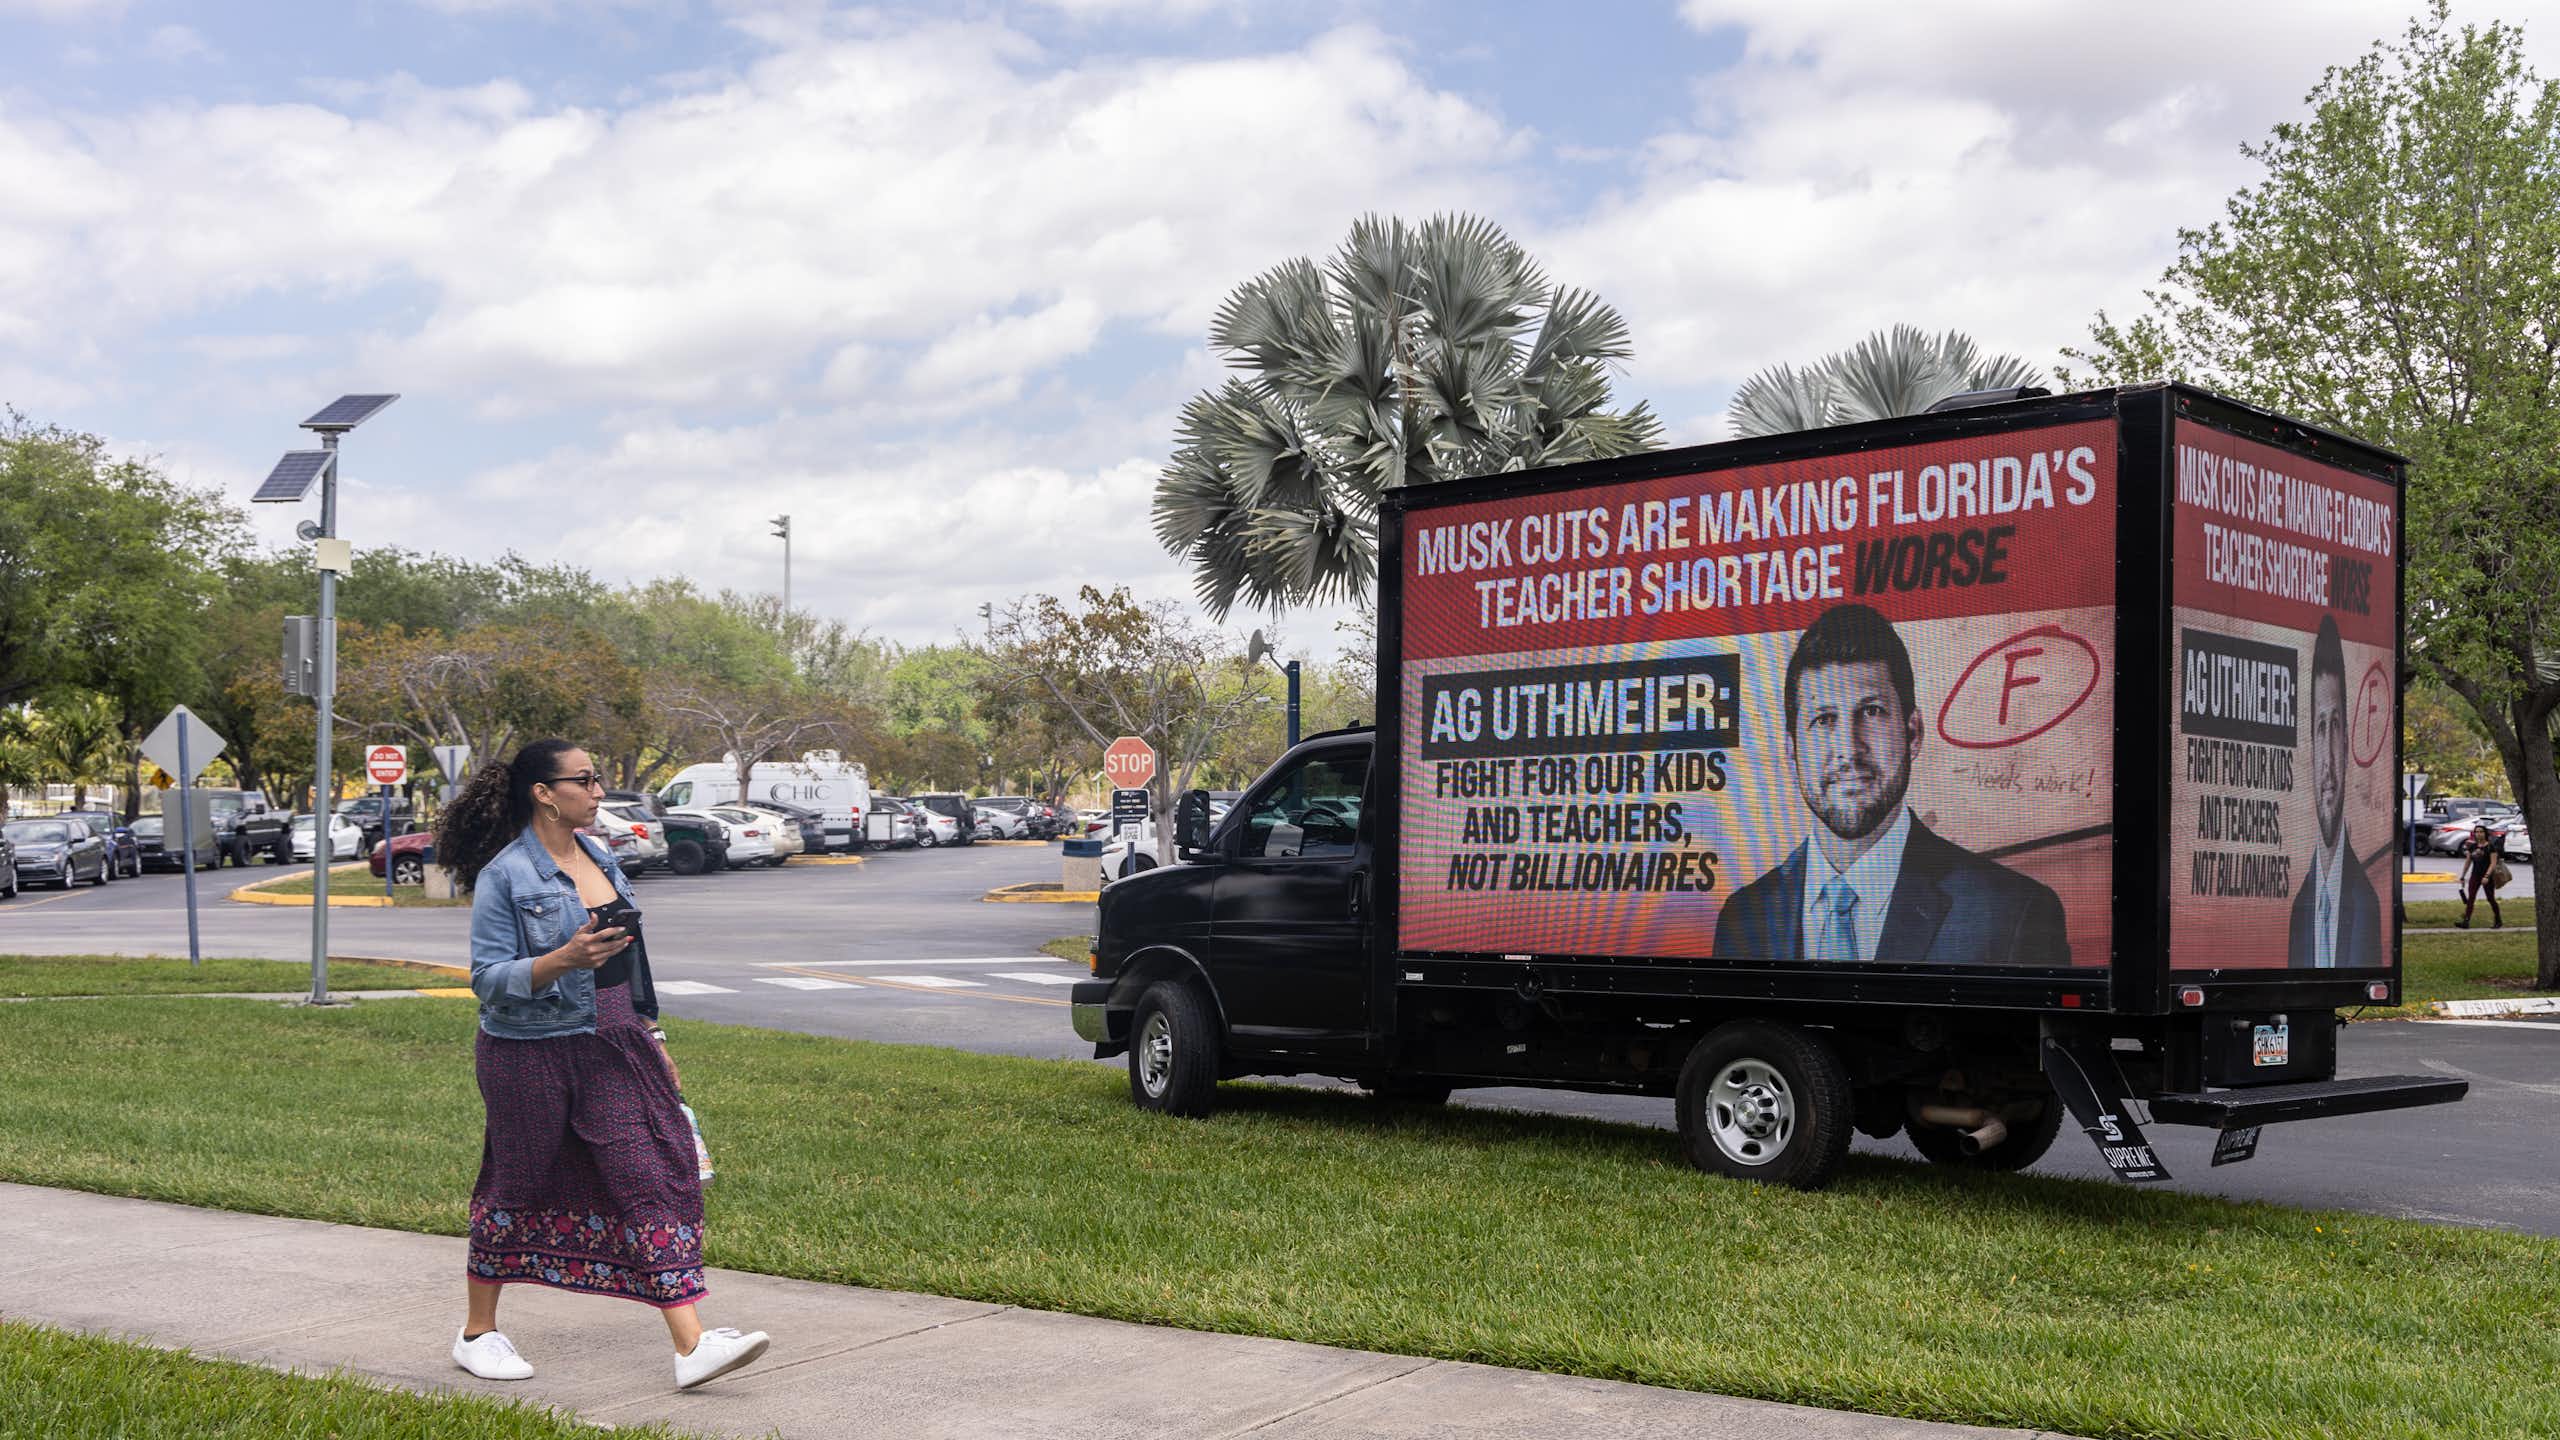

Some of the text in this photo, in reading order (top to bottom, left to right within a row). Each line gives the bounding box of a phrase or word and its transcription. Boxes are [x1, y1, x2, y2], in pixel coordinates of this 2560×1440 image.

[1417, 446, 2097, 576] MUSK CUTS ARE MAKING FLORIDA'S
[2179, 444, 2391, 557] MUSK CUTS ARE MAKING FLORIDA'S
[1475, 525, 2016, 629] TEACHER SHORTAGE WORSE
[2204, 522, 2373, 616] TEACHER SHORTAGE WORSE
[1430, 673, 1730, 744] AG UTHMEIER:
[1998, 647, 2044, 725] F
[2184, 648, 2295, 728] AG UTHMEIER:
[373, 753, 399, 761] DO NOT
[1107, 753, 1152, 774] STOP
[1436, 751, 1727, 799] FIGHT FOR OUR KIDS
[2187, 737, 2293, 793] FIGHT FOR OUR KIDS
[1462, 802, 1692, 848] AND TEACHERS,
[2198, 795, 2282, 850] AND TEACHERS,
[1448, 851, 1719, 892] NOT BILLIONAIRES
[2192, 850, 2290, 899] NOT BILLIONAIRES
[2103, 1145, 2155, 1169] SUPREME
